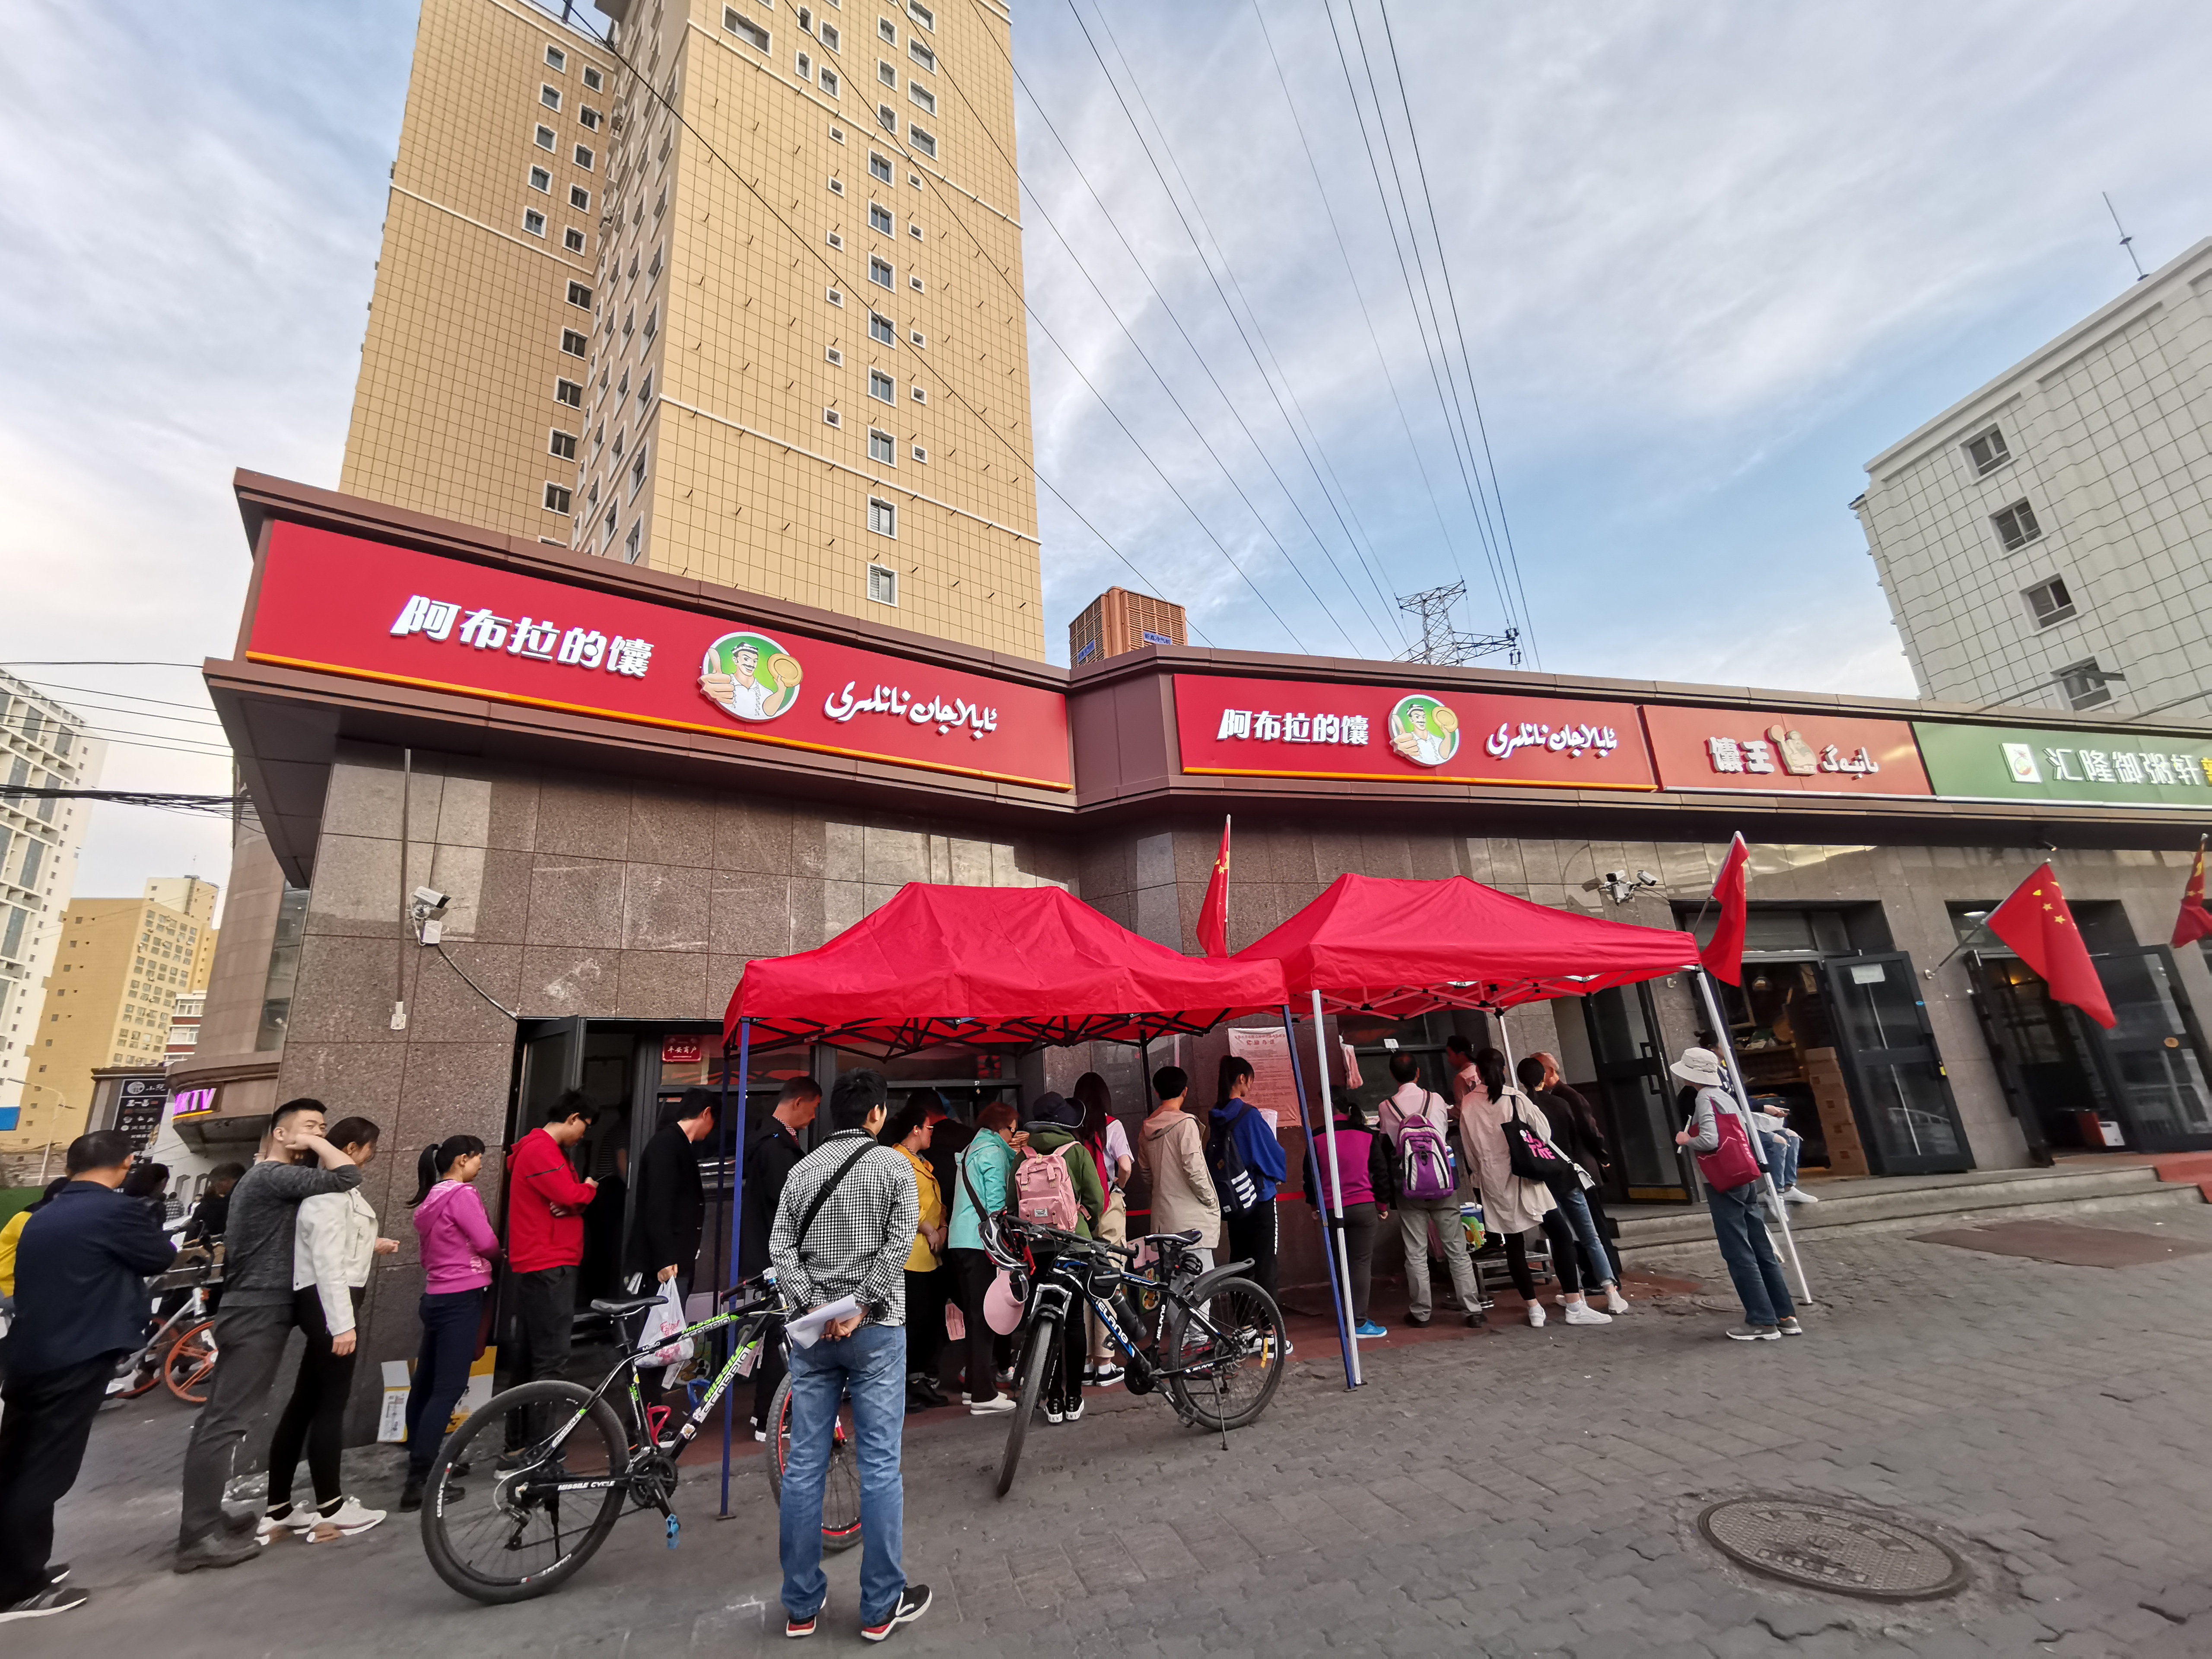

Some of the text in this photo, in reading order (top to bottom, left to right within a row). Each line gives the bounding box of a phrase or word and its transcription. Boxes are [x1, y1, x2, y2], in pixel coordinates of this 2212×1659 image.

[390, 594, 655, 678] 阿布拉的馕
[1216, 708, 1369, 746] 阿布拉的馕
[1707, 736, 1775, 773] 馕王
[1156, 1304, 1166, 1341] JIELANG
[704, 1345, 744, 1402] MISSILE
[704, 1351, 749, 1413] SCORPIO
[557, 1481, 589, 1491] MISSILE
